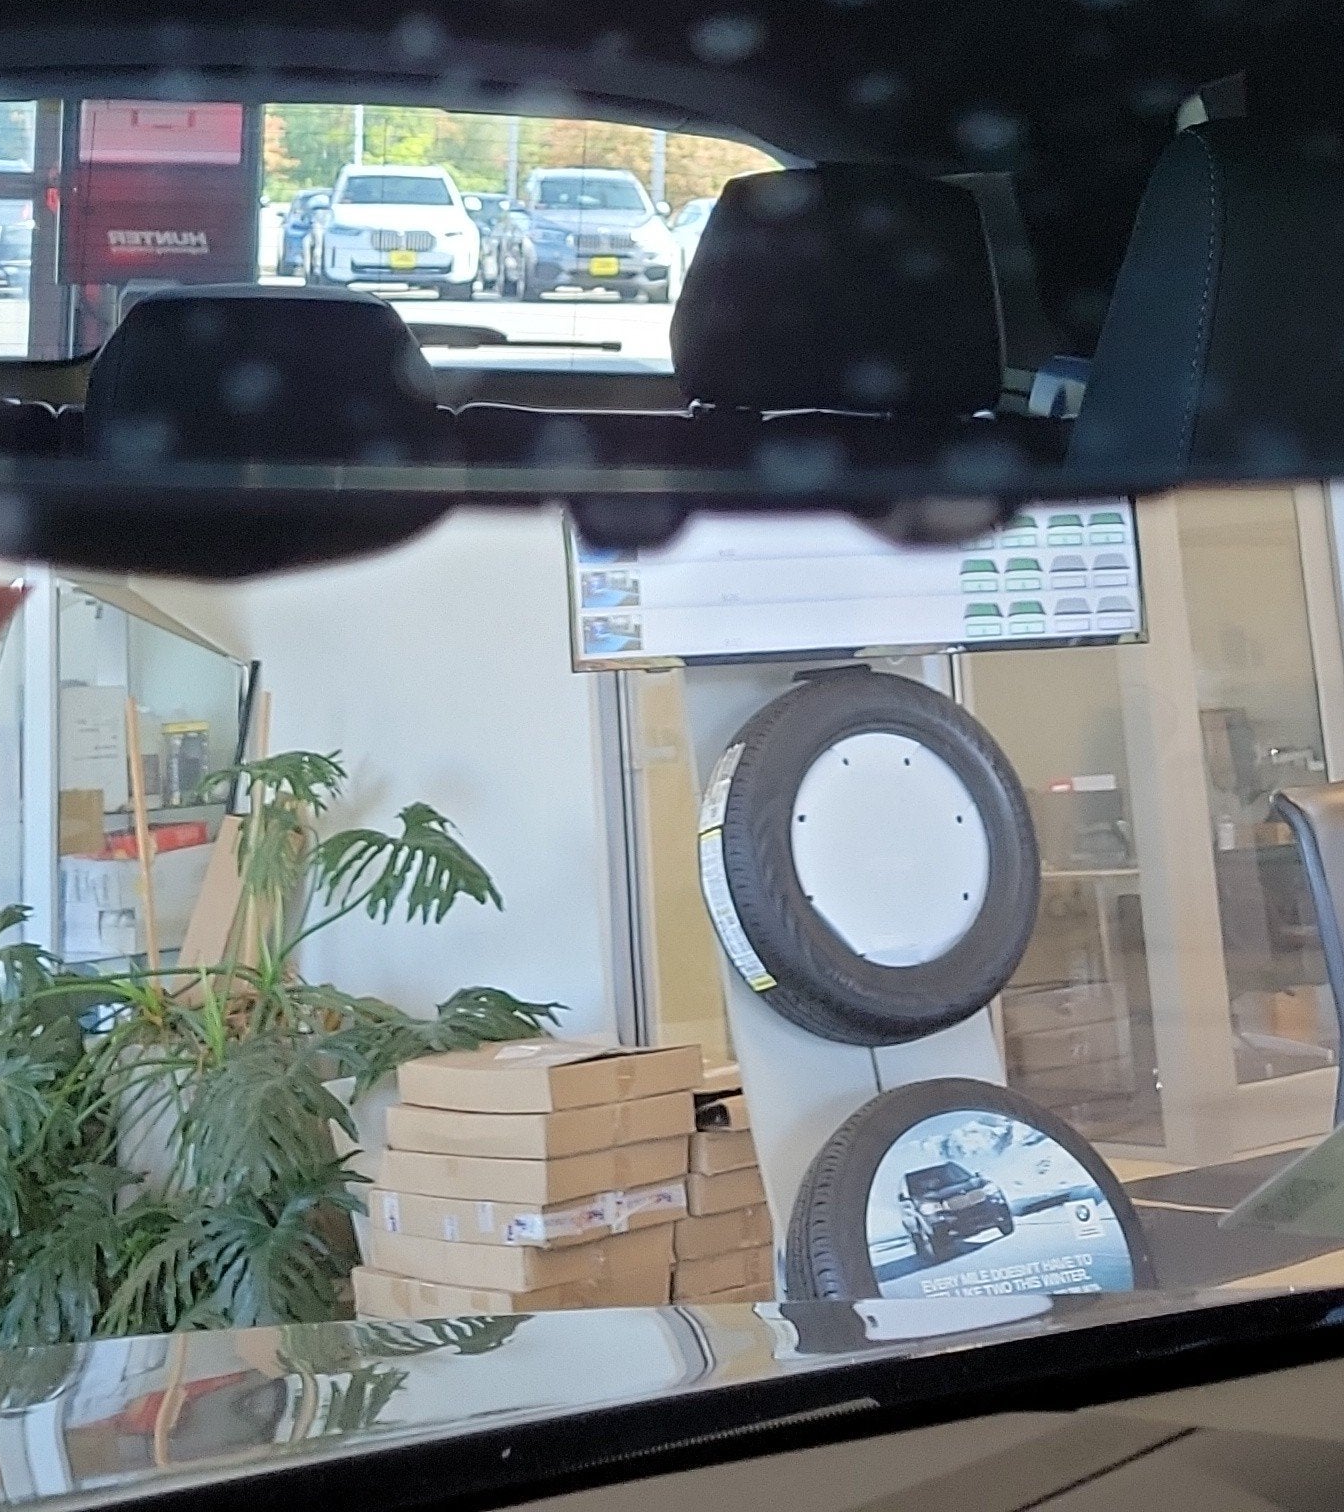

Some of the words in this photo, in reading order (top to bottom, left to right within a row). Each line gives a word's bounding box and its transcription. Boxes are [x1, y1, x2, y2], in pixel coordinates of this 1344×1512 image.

[921, 1276, 958, 1293] EVERY
[959, 1270, 991, 1287] MILE
[1043, 1256, 1075, 1271] HAVE
[1075, 1253, 1092, 1267] TO
[1011, 1276, 1043, 1292] THIS
